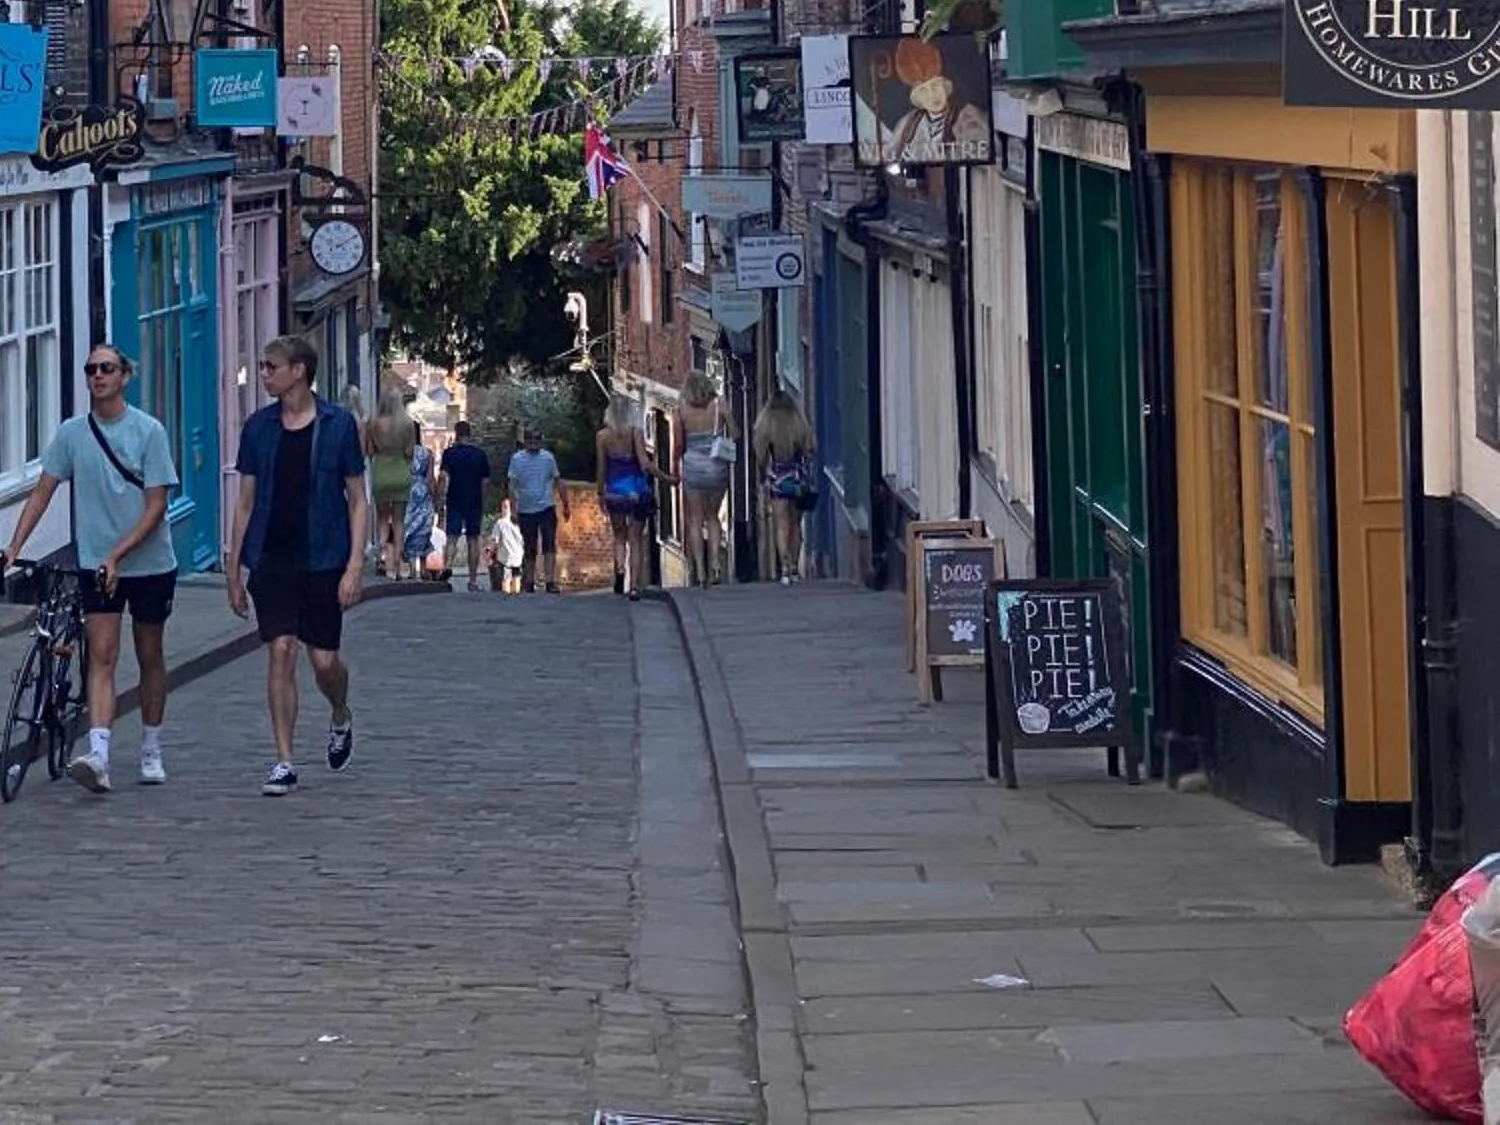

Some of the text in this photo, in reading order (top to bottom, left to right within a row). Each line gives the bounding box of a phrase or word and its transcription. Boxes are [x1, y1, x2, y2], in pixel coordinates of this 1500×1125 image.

[1306, 2, 1459, 91] HOMEWARES
[207, 70, 264, 96] Naked
[41, 109, 137, 161] Cahoots
[923, 140, 989, 162] MITRE
[942, 564, 982, 583] DOGS
[1023, 599, 1091, 630] PIE!
[1027, 634, 1094, 666] PIE!
